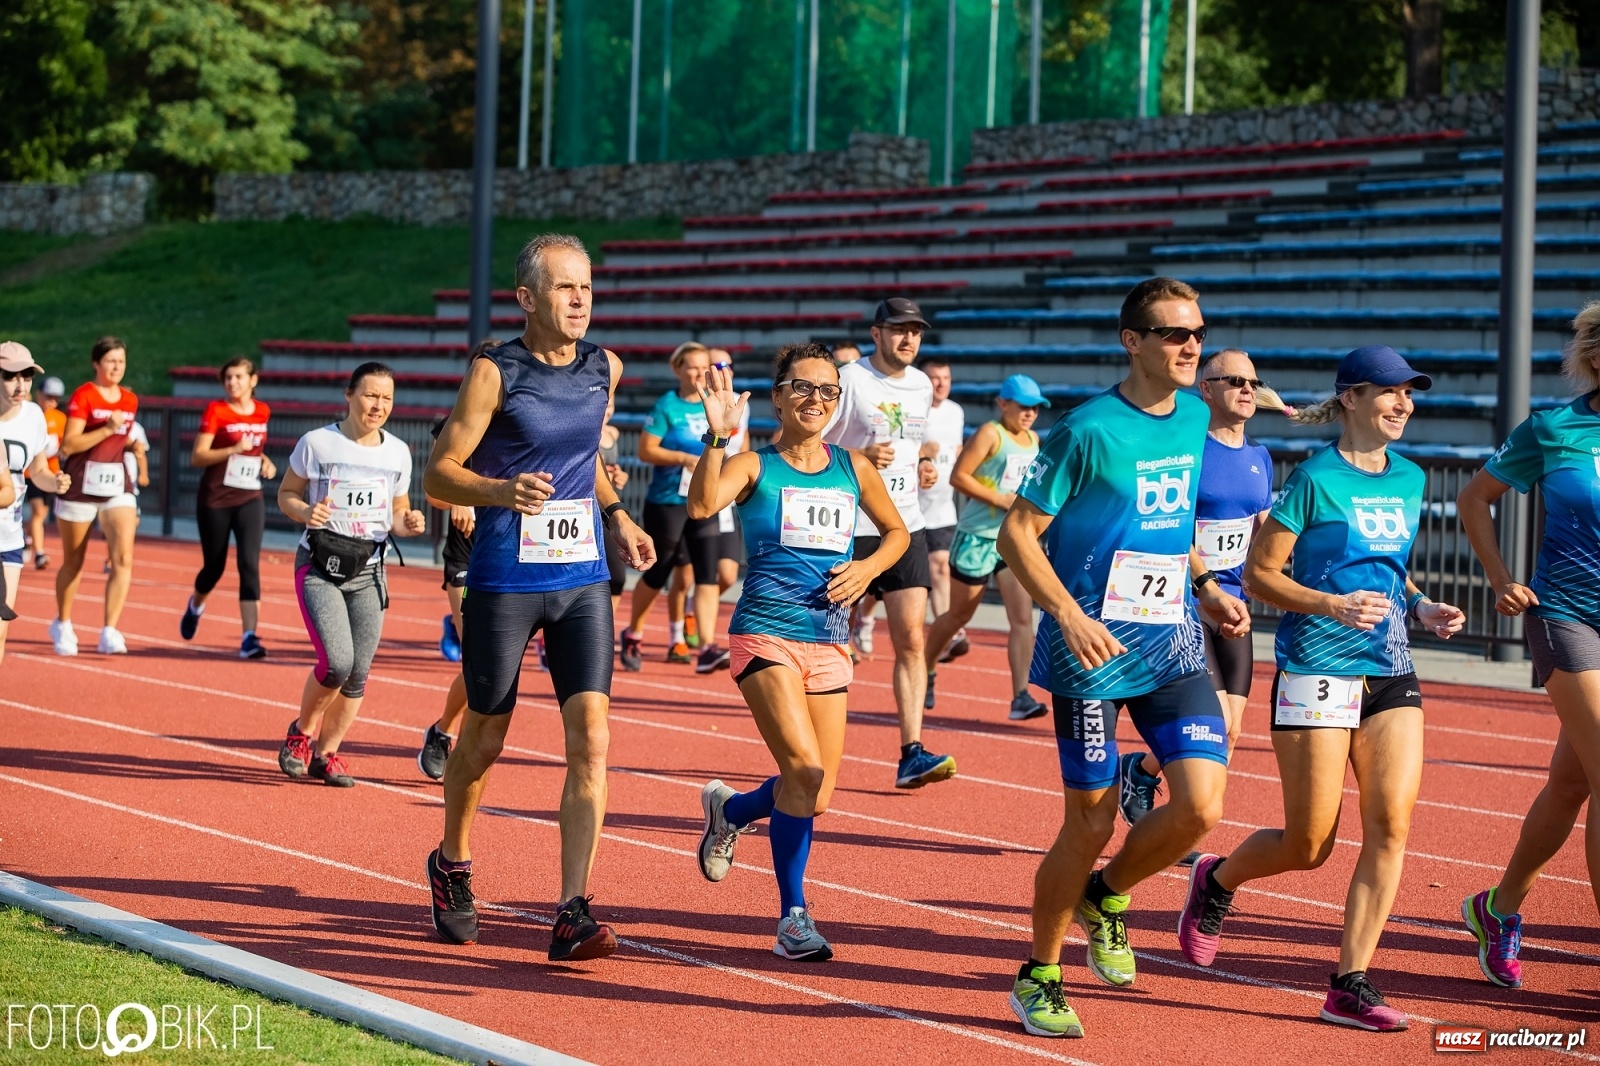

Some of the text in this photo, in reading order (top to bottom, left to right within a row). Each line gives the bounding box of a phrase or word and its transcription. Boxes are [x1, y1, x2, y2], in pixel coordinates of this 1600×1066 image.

[3, 439, 28, 474] D
[1136, 454, 1194, 471] BiegamBoLubię
[891, 477, 905, 491] 73
[1136, 469, 1191, 515] bbl
[346, 491, 373, 506] 161
[806, 505, 841, 529] 101
[1141, 518, 1180, 530] RACIBÓRZ
[1354, 507, 1411, 540] bbl
[546, 517, 579, 540] 106
[1217, 533, 1244, 551] 157
[1141, 574, 1167, 597] 72
[1317, 679, 1330, 701] 3
